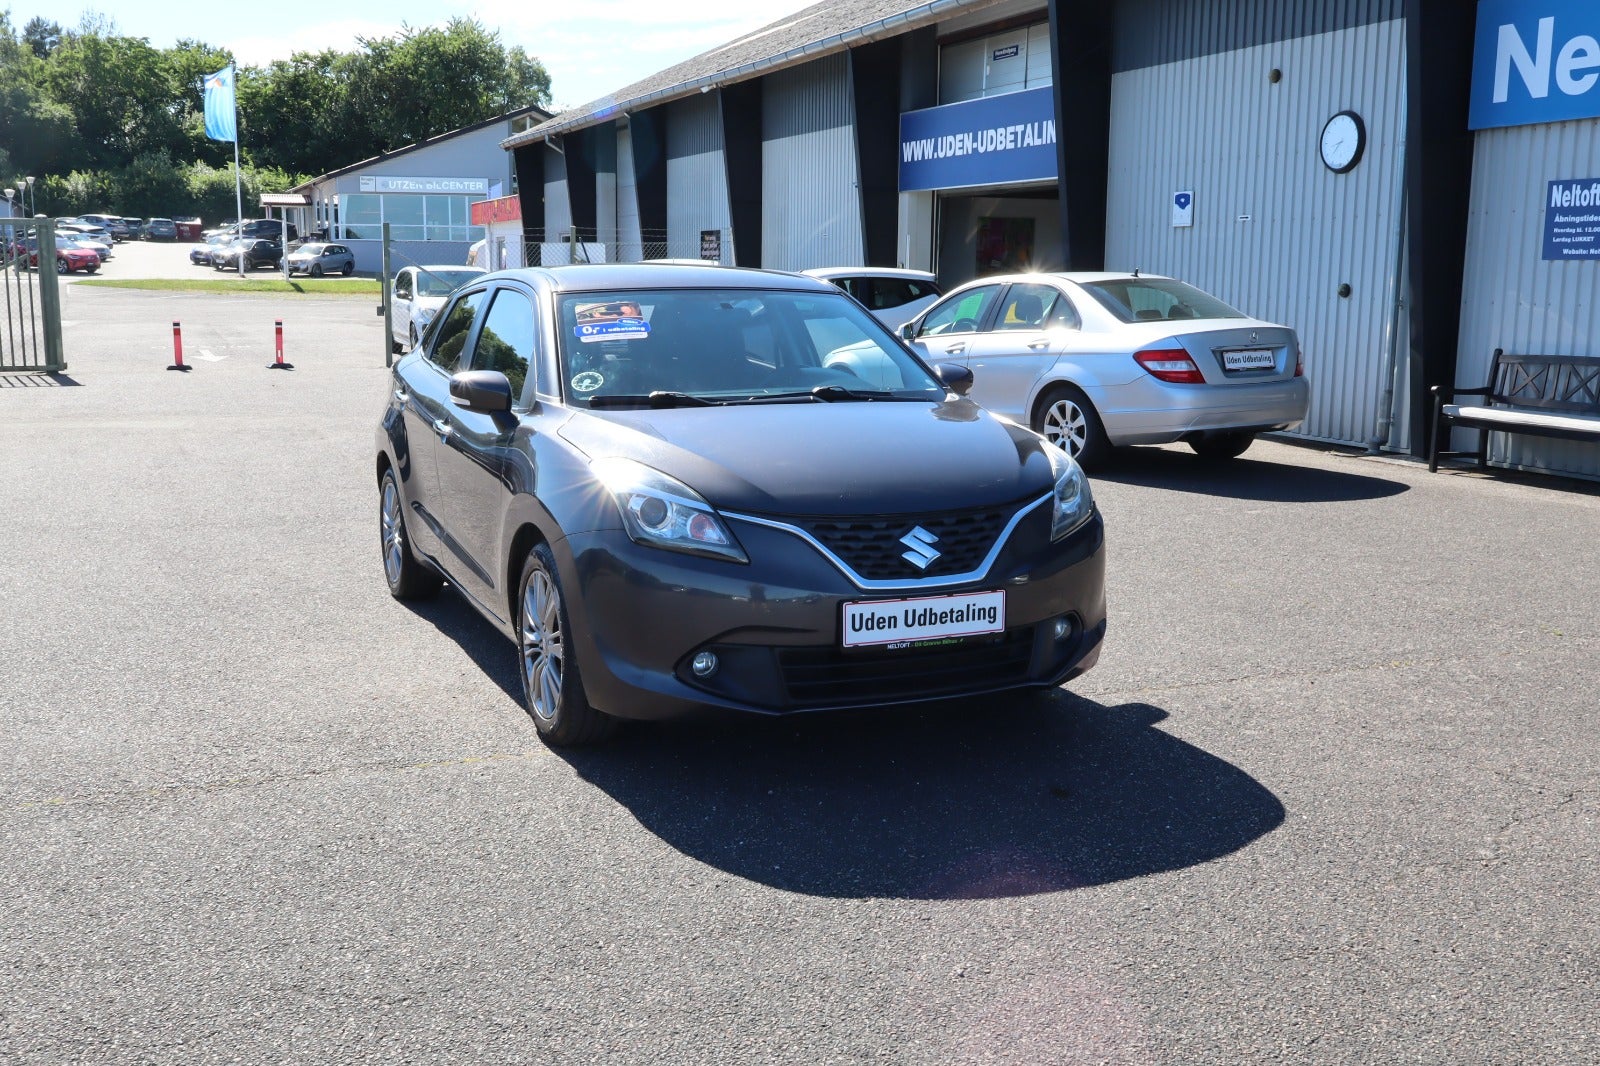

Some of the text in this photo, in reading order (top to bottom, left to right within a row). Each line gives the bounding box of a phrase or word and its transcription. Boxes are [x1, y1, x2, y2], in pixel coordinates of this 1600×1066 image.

[1493, 16, 1600, 104] Ne
[902, 119, 1057, 163] WWW.UDEN-UDBETALIN
[1551, 183, 1600, 208] Neltoft
[1227, 355, 1271, 364] Uden Udbetaling
[851, 603, 997, 633] Uden Udbetaling
[887, 641, 910, 649] NELTOFT
